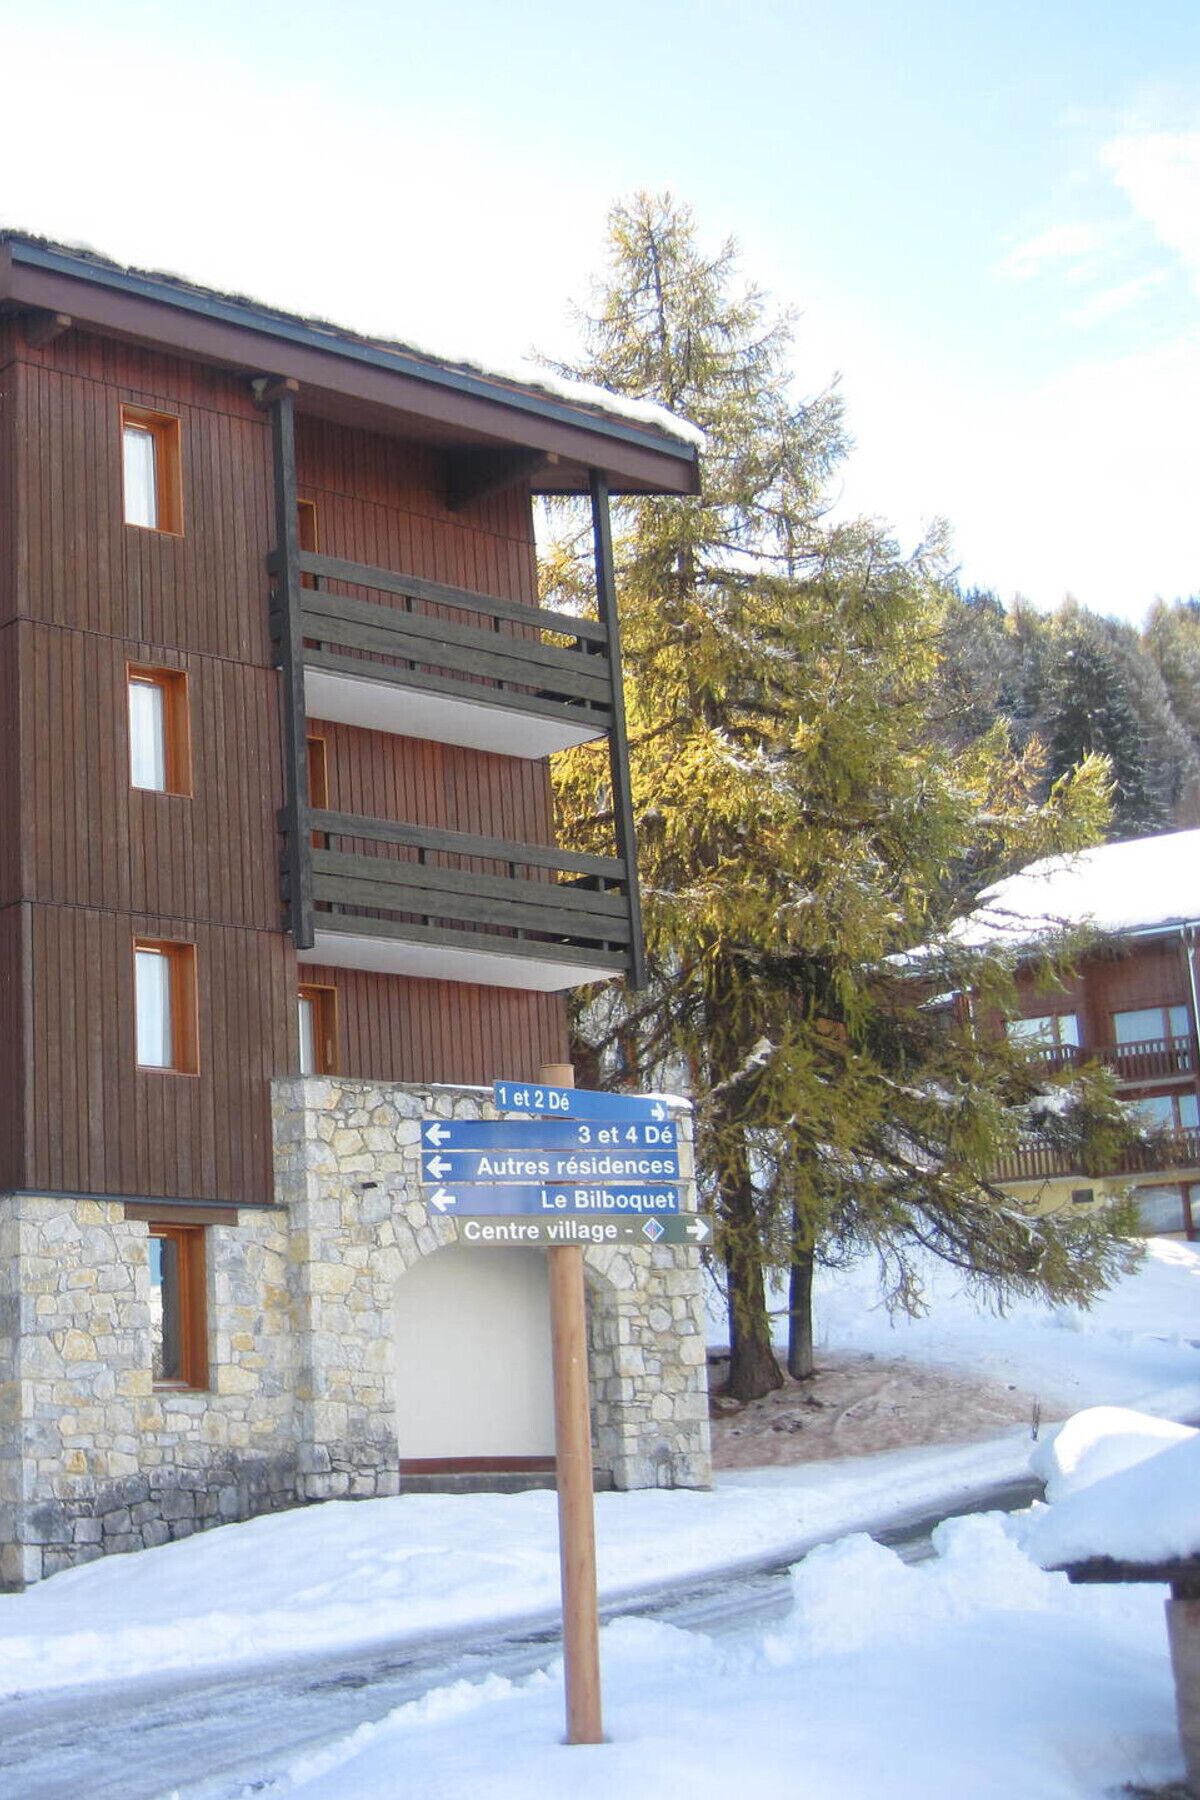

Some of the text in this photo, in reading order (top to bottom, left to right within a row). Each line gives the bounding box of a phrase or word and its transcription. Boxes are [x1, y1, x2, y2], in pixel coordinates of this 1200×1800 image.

[499, 1087, 569, 1111] 1 et 2 Dé
[578, 1125, 672, 1143] 3 et 4 Dé
[477, 1156, 675, 1175] Autres résidences
[542, 1189, 675, 1213] Le Bilboquet
[464, 1221, 540, 1240] Centre
[546, 1220, 617, 1244] village
